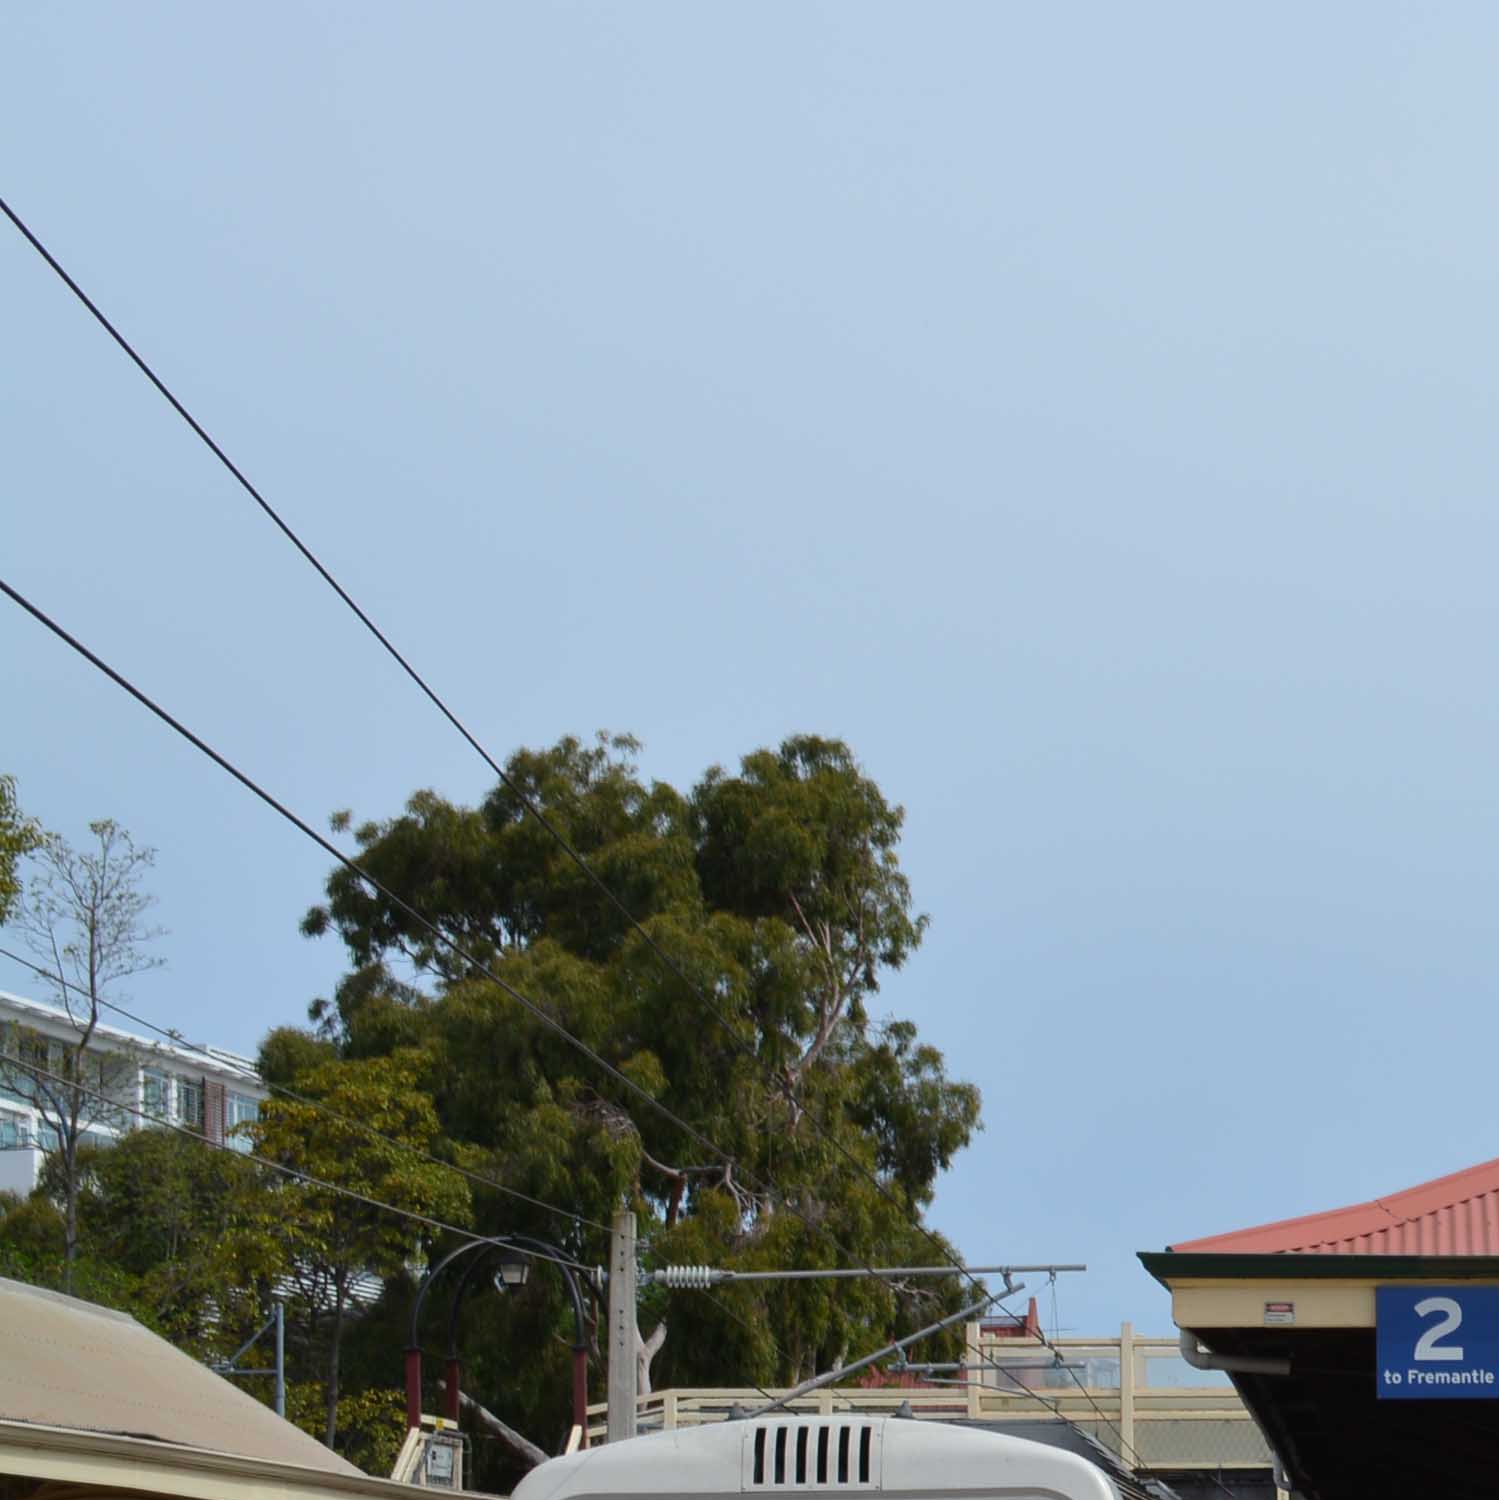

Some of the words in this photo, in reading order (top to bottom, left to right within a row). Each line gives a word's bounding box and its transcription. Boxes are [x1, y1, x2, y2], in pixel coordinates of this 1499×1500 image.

[1413, 1296, 1464, 1361] 2
[1383, 1370, 1402, 1386] to
[1407, 1368, 1496, 1386] Fremantle
